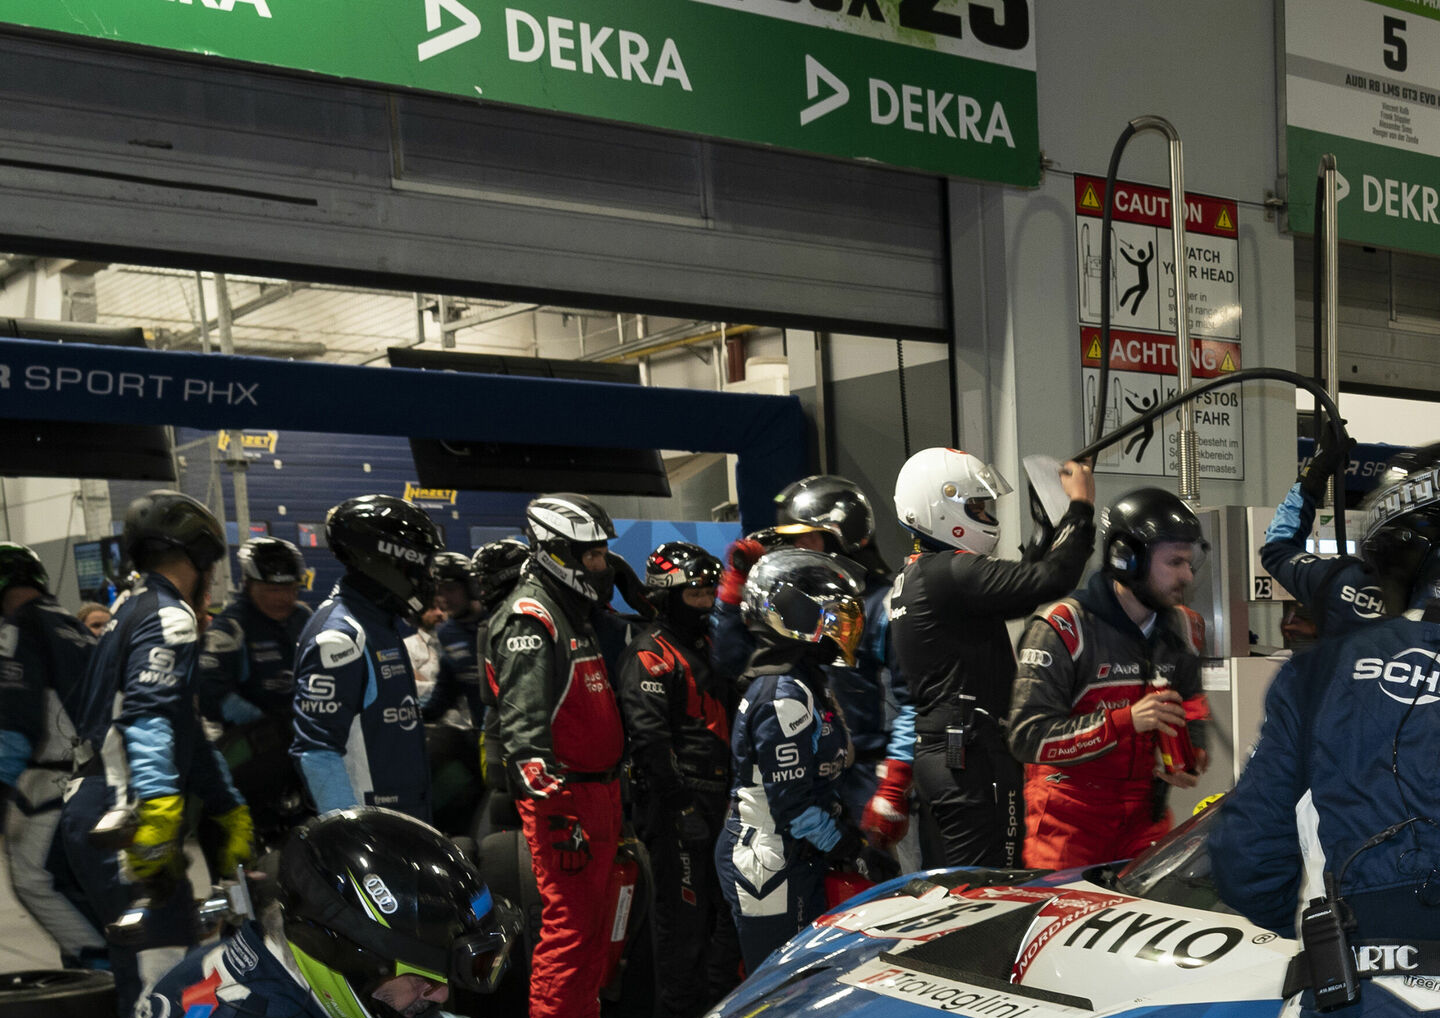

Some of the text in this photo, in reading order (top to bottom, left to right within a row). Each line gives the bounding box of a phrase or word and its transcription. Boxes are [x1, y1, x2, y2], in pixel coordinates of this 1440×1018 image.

[505, 8, 692, 91] DEKRA
[1383, 14, 1408, 73] 5
[1346, 74, 1367, 88] AUDI
[1382, 83, 1400, 97] LMS
[1402, 87, 1418, 102] GT3
[1420, 91, 1436, 106] EVO
[869, 78, 1016, 148] DEKRA
[1115, 190, 1202, 224] CAUTON
[1163, 262, 1234, 284] YR HEAD
[24, 365, 172, 400] SPORT
[184, 379, 260, 406] PHX
[1176, 410, 1230, 427] FAHR
[378, 539, 428, 566] uvex
[1256, 578, 1272, 598] 23
[139, 670, 178, 688] HYLO
[301, 702, 338, 714] HYLO
[1058, 736, 1102, 758] Audi Sport
[772, 768, 804, 783] HYLO
[1006, 790, 1017, 868] udi Sport
[680, 852, 692, 886] Audi
[1018, 897, 1125, 970] NORDRHEIN
[1064, 909, 1244, 969] HYLO
